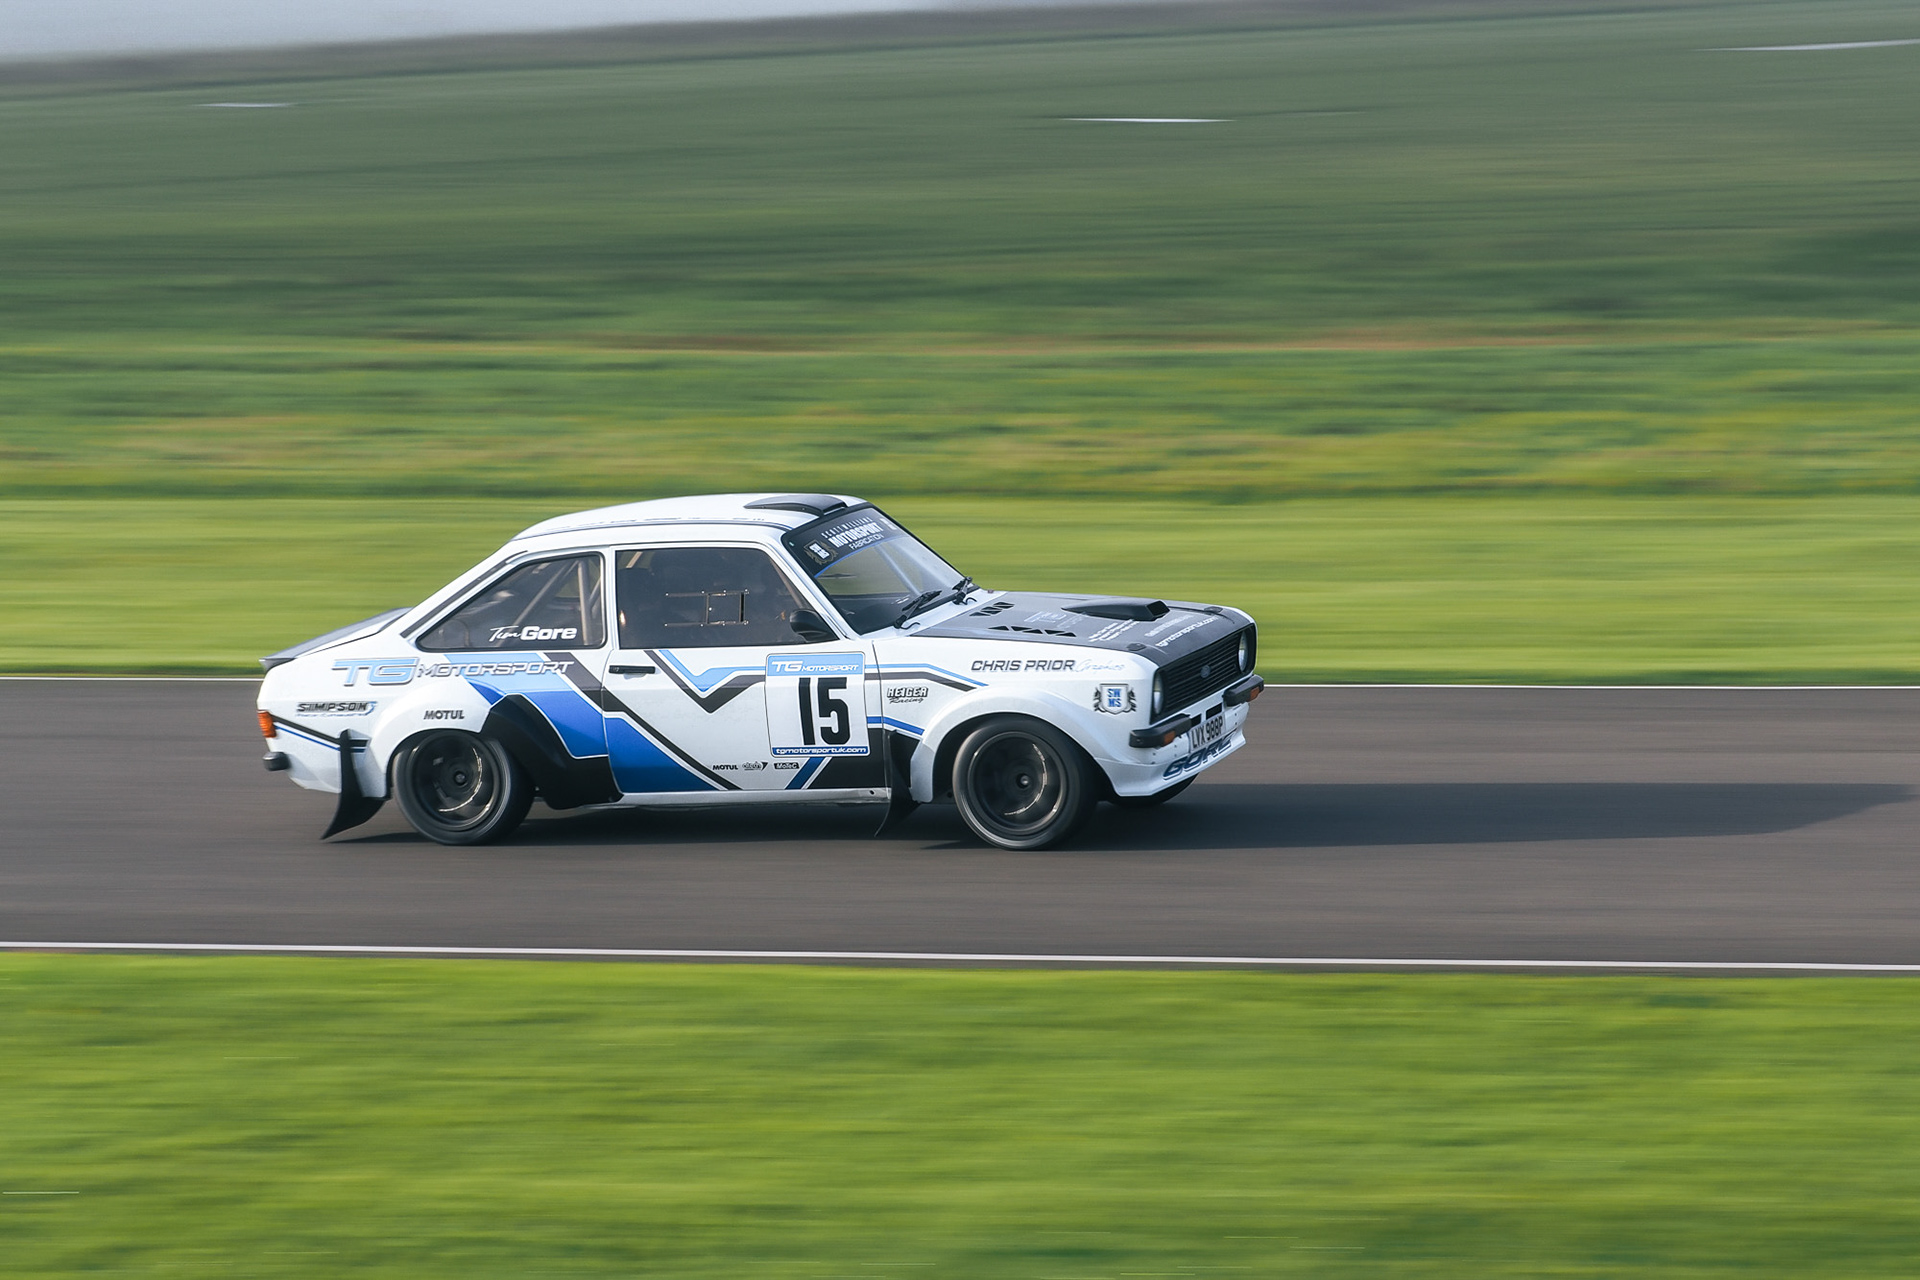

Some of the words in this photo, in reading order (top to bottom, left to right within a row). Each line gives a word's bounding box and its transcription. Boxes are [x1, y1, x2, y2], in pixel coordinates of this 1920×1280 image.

[828, 522, 884, 548] MOTORSPORT
[849, 534, 885, 550] FABRICATION
[489, 626, 520, 642] Tim
[520, 626, 578, 641] Gore
[771, 660, 803, 672] TG
[802, 664, 859, 672] MOTORSPORT
[971, 660, 1021, 671] CHRIS
[1024, 659, 1076, 671] PRIOR
[331, 657, 419, 687] TG
[417, 660, 574, 678] MOTORSPORT
[886, 687, 929, 698] REIGER
[1107, 688, 1121, 698] SW
[889, 696, 924, 705] Racing
[296, 702, 368, 712] SIMPSON
[799, 677, 851, 745] 15
[423, 710, 465, 720] MOTUL
[775, 747, 867, 755] tgmotorsportuk.com
